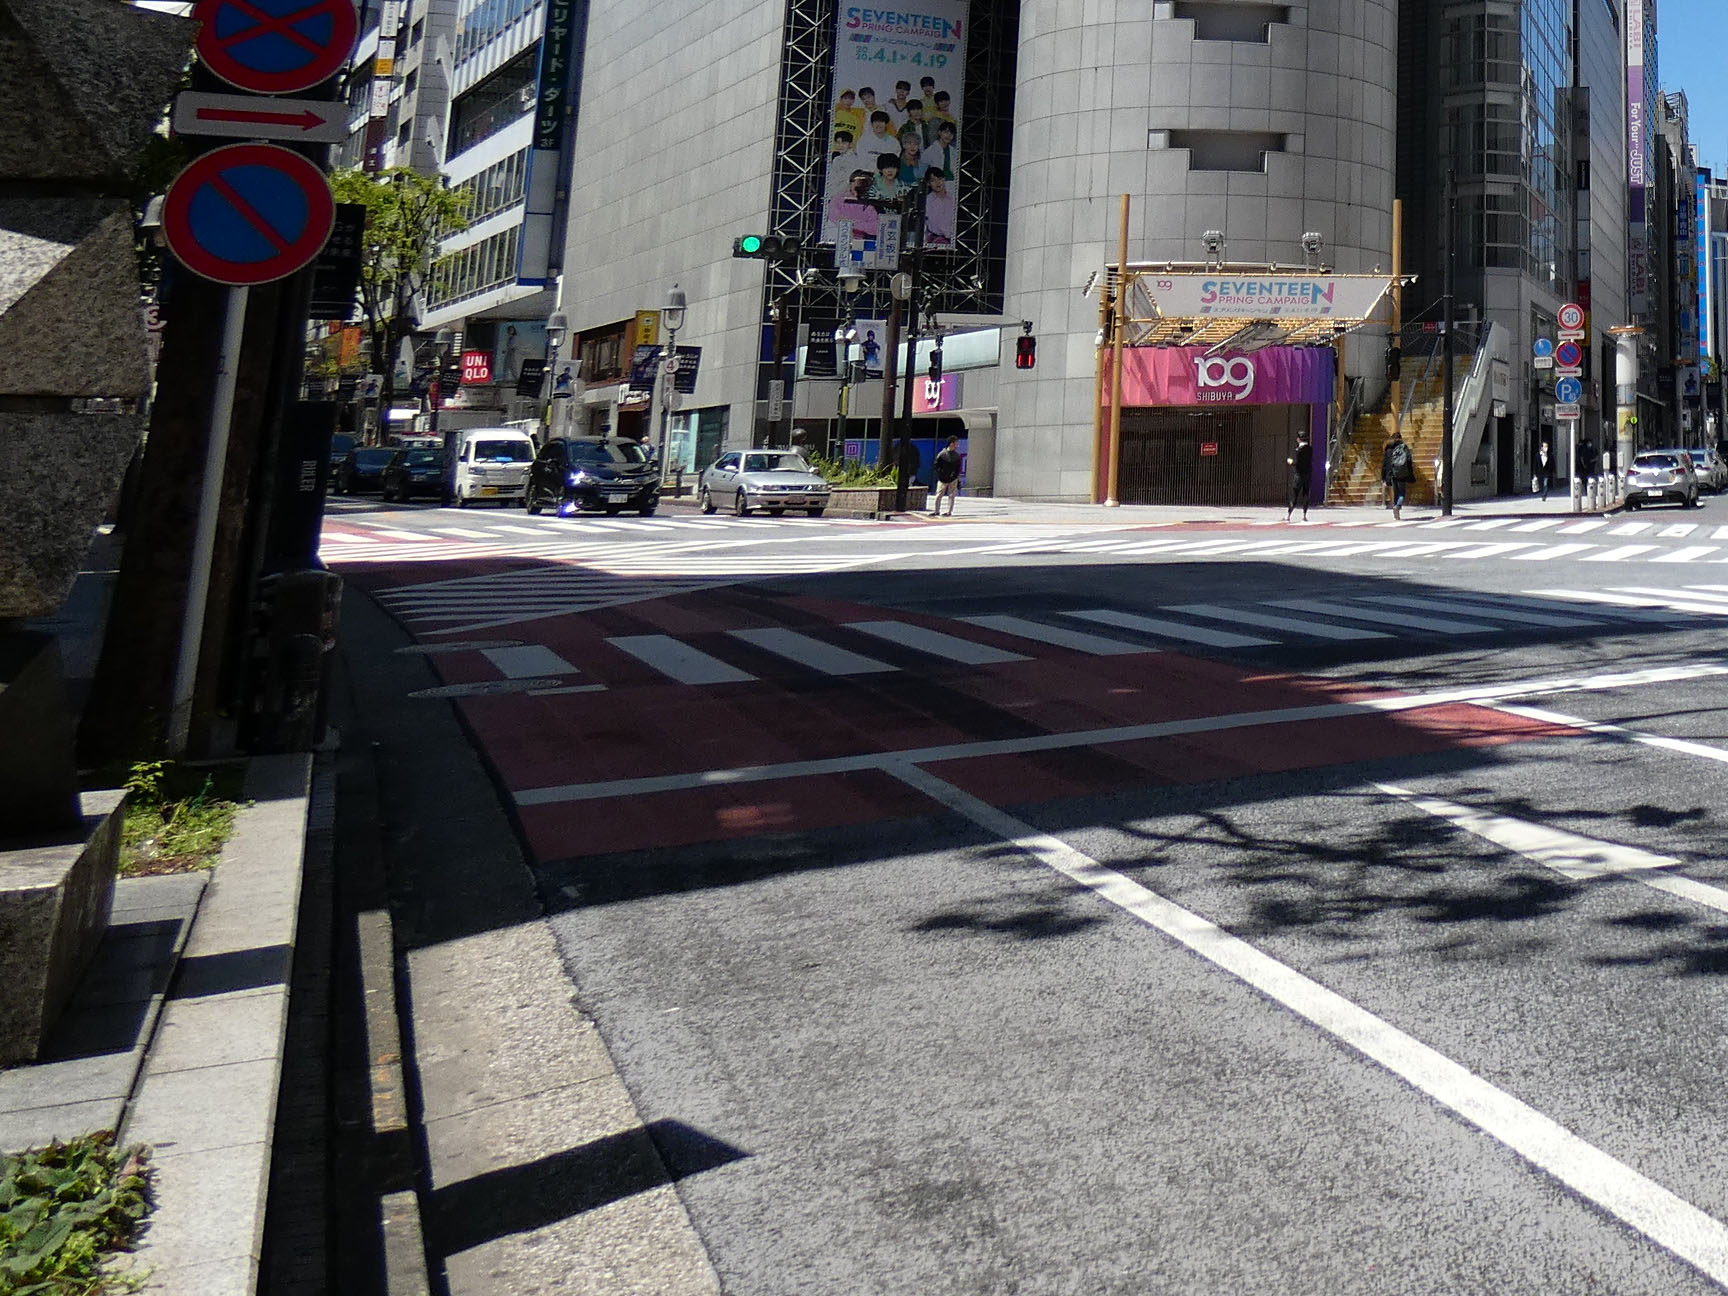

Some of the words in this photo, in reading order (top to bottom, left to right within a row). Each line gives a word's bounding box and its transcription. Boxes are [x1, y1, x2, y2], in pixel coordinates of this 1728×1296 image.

[846, 7, 962, 41] SEVENTEEN
[1632, 9, 1641, 49] LABI
[1631, 102, 1641, 120] For
[1630, 119, 1642, 143] Your
[1636, 254, 1645, 295] LABI
[1156, 279, 1173, 291] 109
[1200, 280, 1335, 305] SEVENTEEN
[1563, 311, 1578, 324] 30
[466, 355, 487, 368] UNI
[666, 359, 675, 372] 4
[464, 368, 489, 381] QLO
[1194, 356, 1256, 401] 109
[1196, 391, 1233, 401] SHIBUYA
[1562, 384, 1571, 401] P
